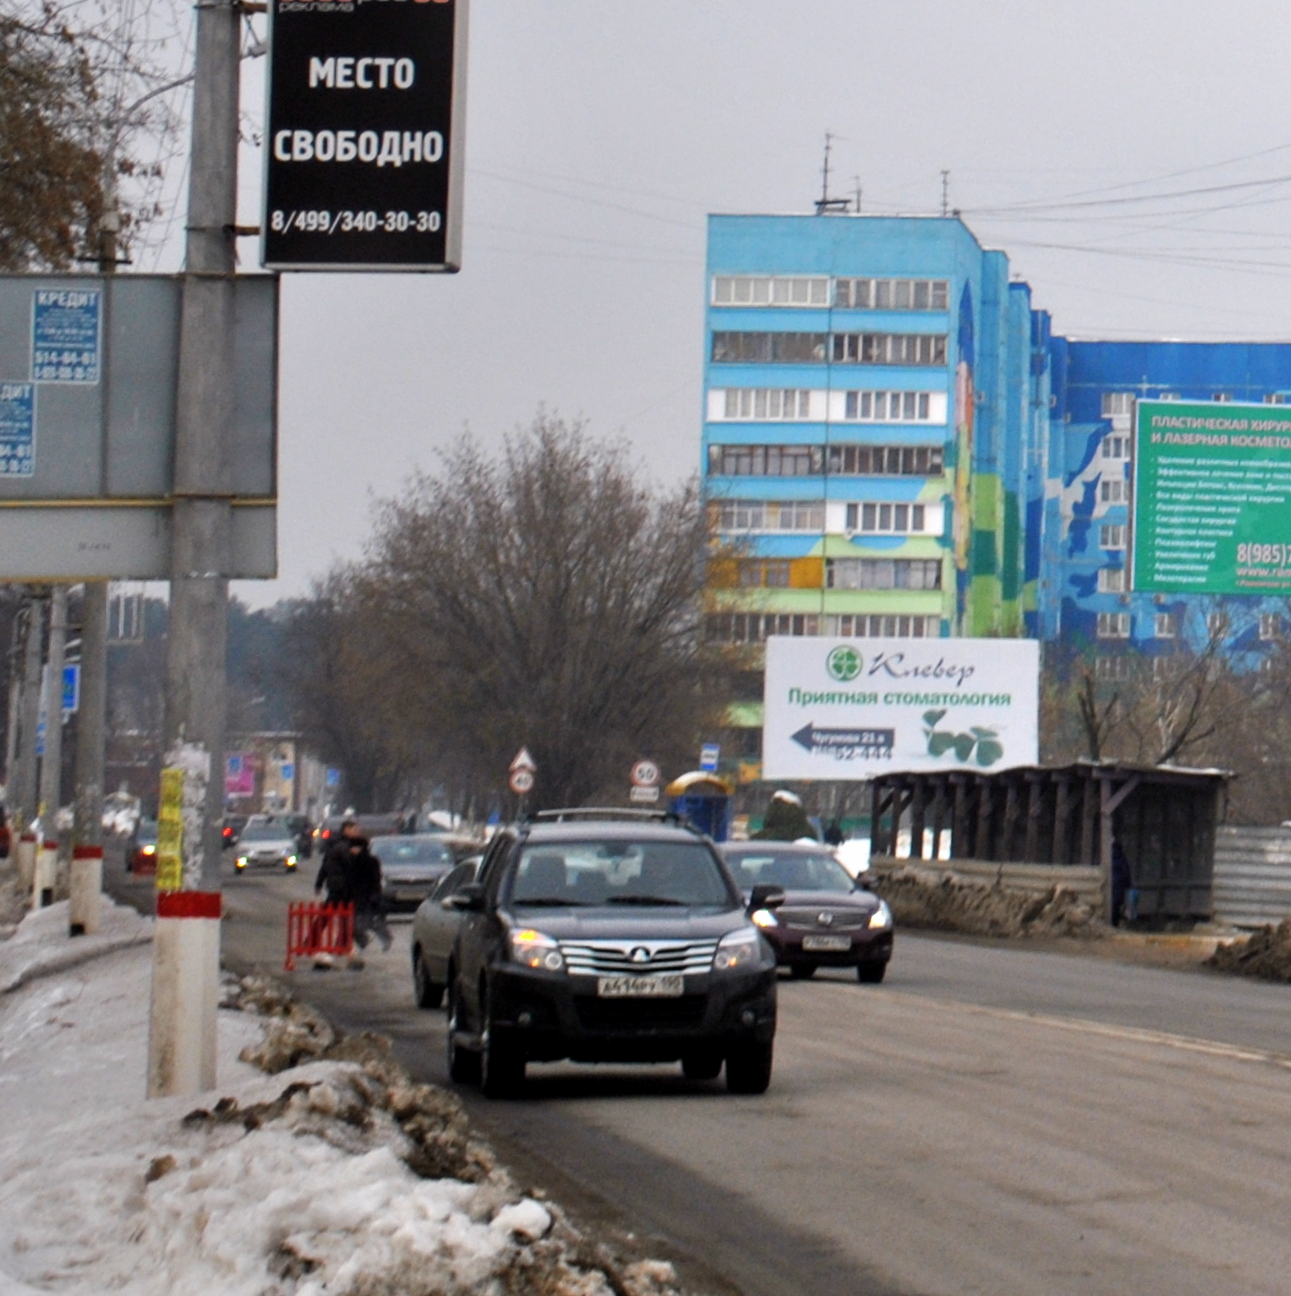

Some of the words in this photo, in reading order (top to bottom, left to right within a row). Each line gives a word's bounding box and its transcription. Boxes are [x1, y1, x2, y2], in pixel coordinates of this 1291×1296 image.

[279, 2, 354, 13] реклама
[308, 57, 415, 89] МЕСТО
[274, 129, 443, 167] СВОБОДНО
[270, 210, 441, 235] 8/499/340-30-30
[37, 291, 97, 308] КРЕДИТ
[1151, 415, 1248, 431] ПЛАСТИЧЕСКАЯ
[1151, 433, 1162, 444] И
[1163, 433, 1228, 447] ЛАЗЕРНАЯ
[868, 651, 976, 687] Клевер
[788, 687, 878, 707] Приятная
[882, 690, 1012, 706] стоматология
